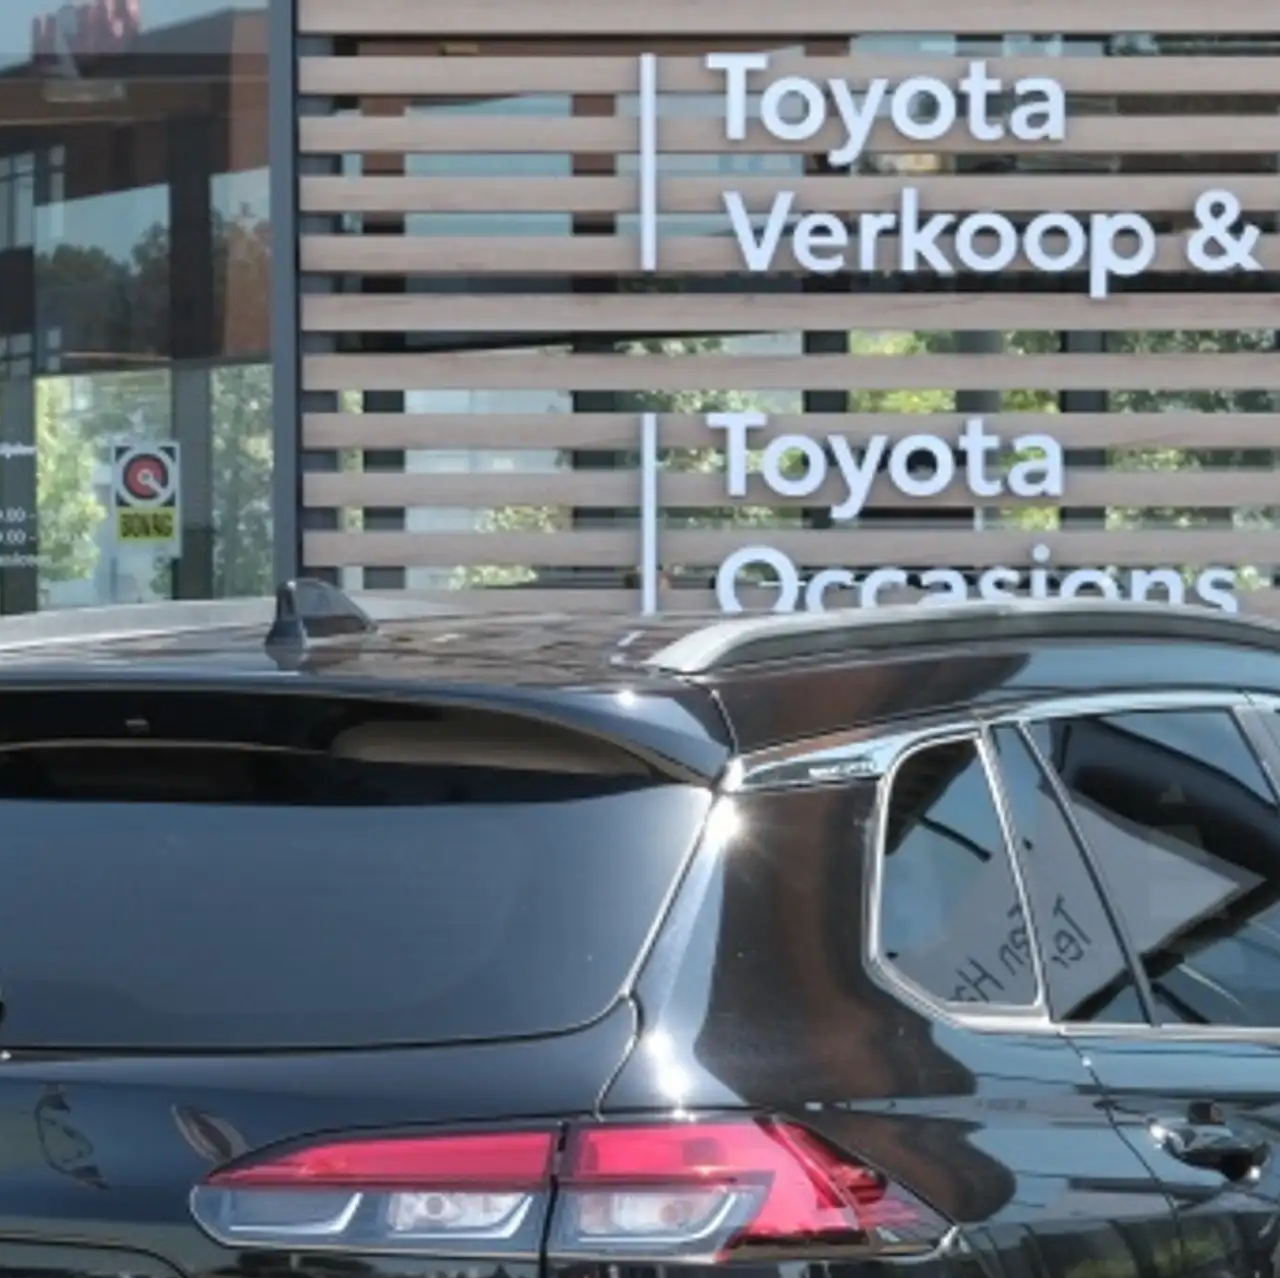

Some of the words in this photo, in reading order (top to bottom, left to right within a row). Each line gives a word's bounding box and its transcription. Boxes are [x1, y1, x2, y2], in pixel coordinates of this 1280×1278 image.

[705, 53, 1066, 167] Toyota
[723, 187, 1156, 299] Verkoop
[1187, 188, 1263, 272] &
[706, 411, 1064, 519] Toyota
